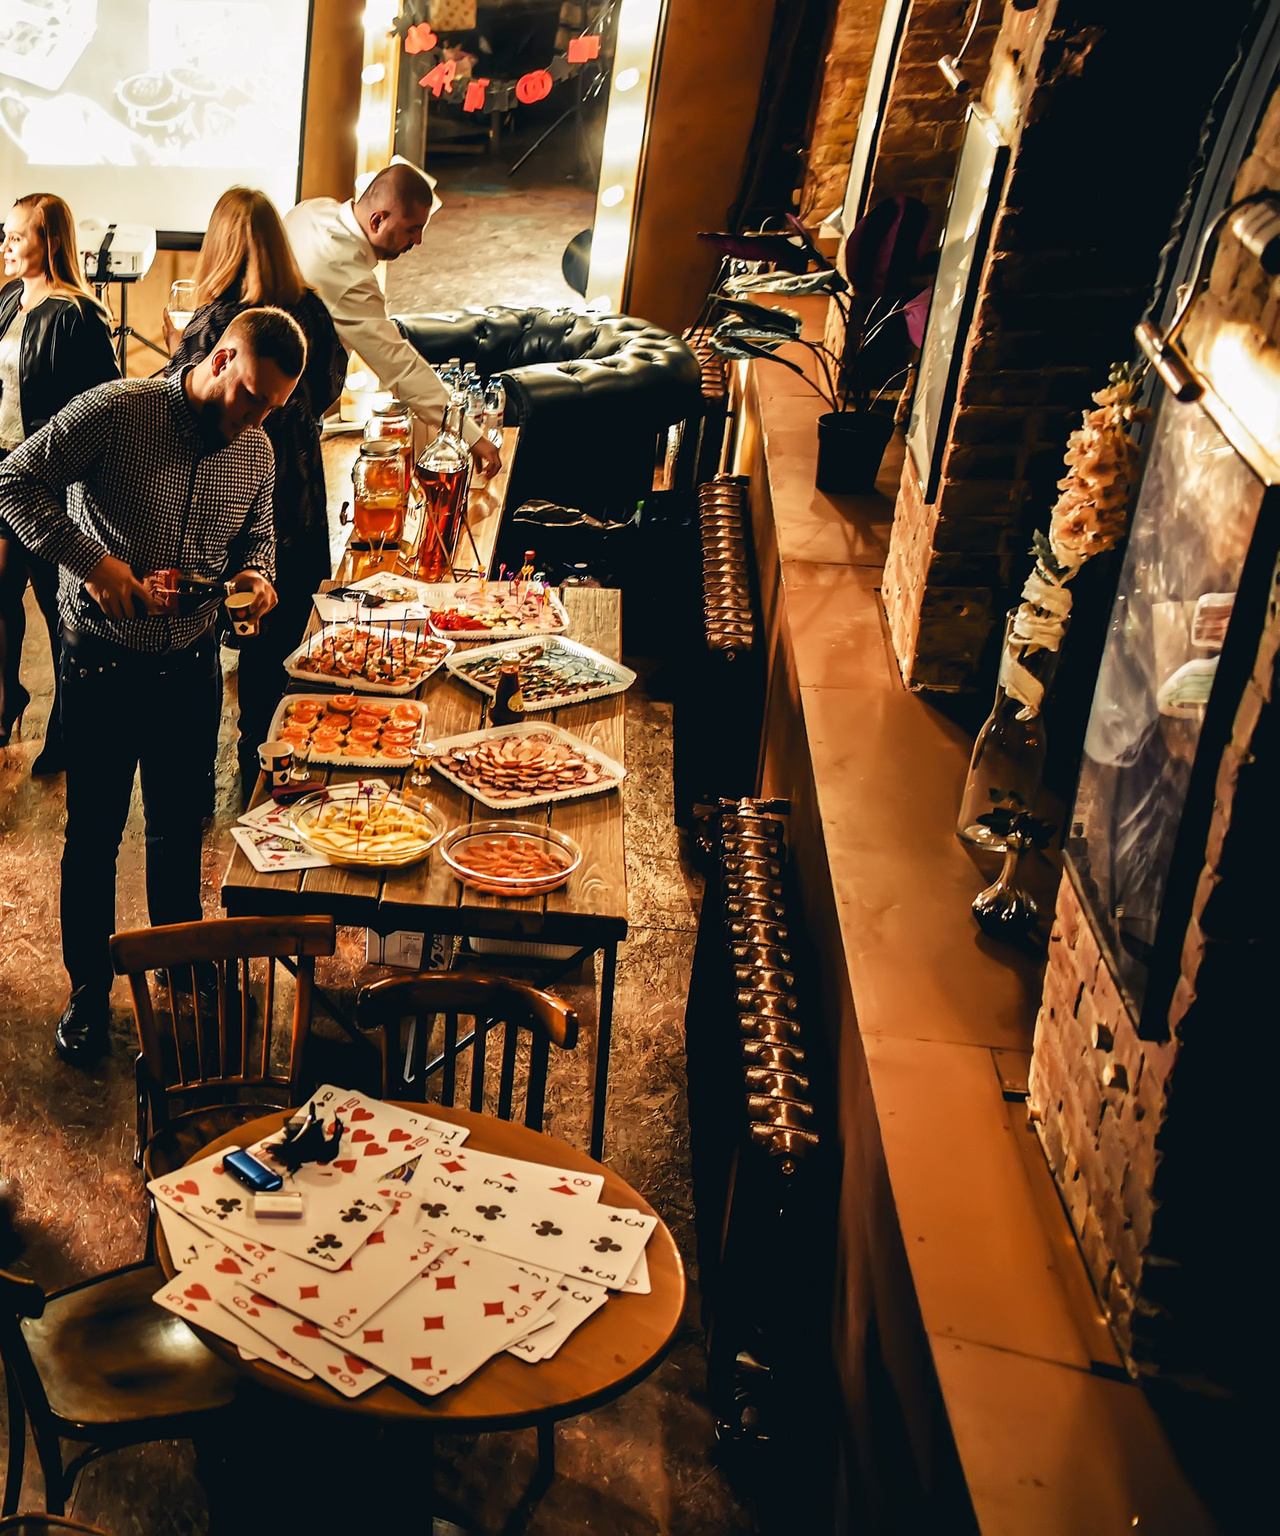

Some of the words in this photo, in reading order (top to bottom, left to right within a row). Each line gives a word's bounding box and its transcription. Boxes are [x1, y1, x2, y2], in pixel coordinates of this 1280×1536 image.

[322, 1091, 334, 1101] Q
[343, 1097, 361, 1109] 10
[412, 1136, 429, 1147] 10
[434, 1148, 452, 1157] 8
[433, 1176, 451, 1188] 2
[483, 1178, 503, 1189] 3
[573, 1178, 592, 1187] 8
[159, 1184, 175, 1196] 8
[201, 1205, 217, 1215] 4
[365, 1203, 383, 1212] 4
[624, 1218, 646, 1229] 3
[450, 1226, 471, 1238] 3
[417, 1241, 434, 1255] 3
[319, 1252, 336, 1262] 4
[595, 1270, 617, 1282] 3
[165, 1293, 184, 1305] 5
[531, 1289, 547, 1302] 4
[571, 1291, 593, 1304] 3
[232, 1296, 249, 1310] 6
[514, 1305, 532, 1318] 5
[333, 1314, 351, 1328] 3
